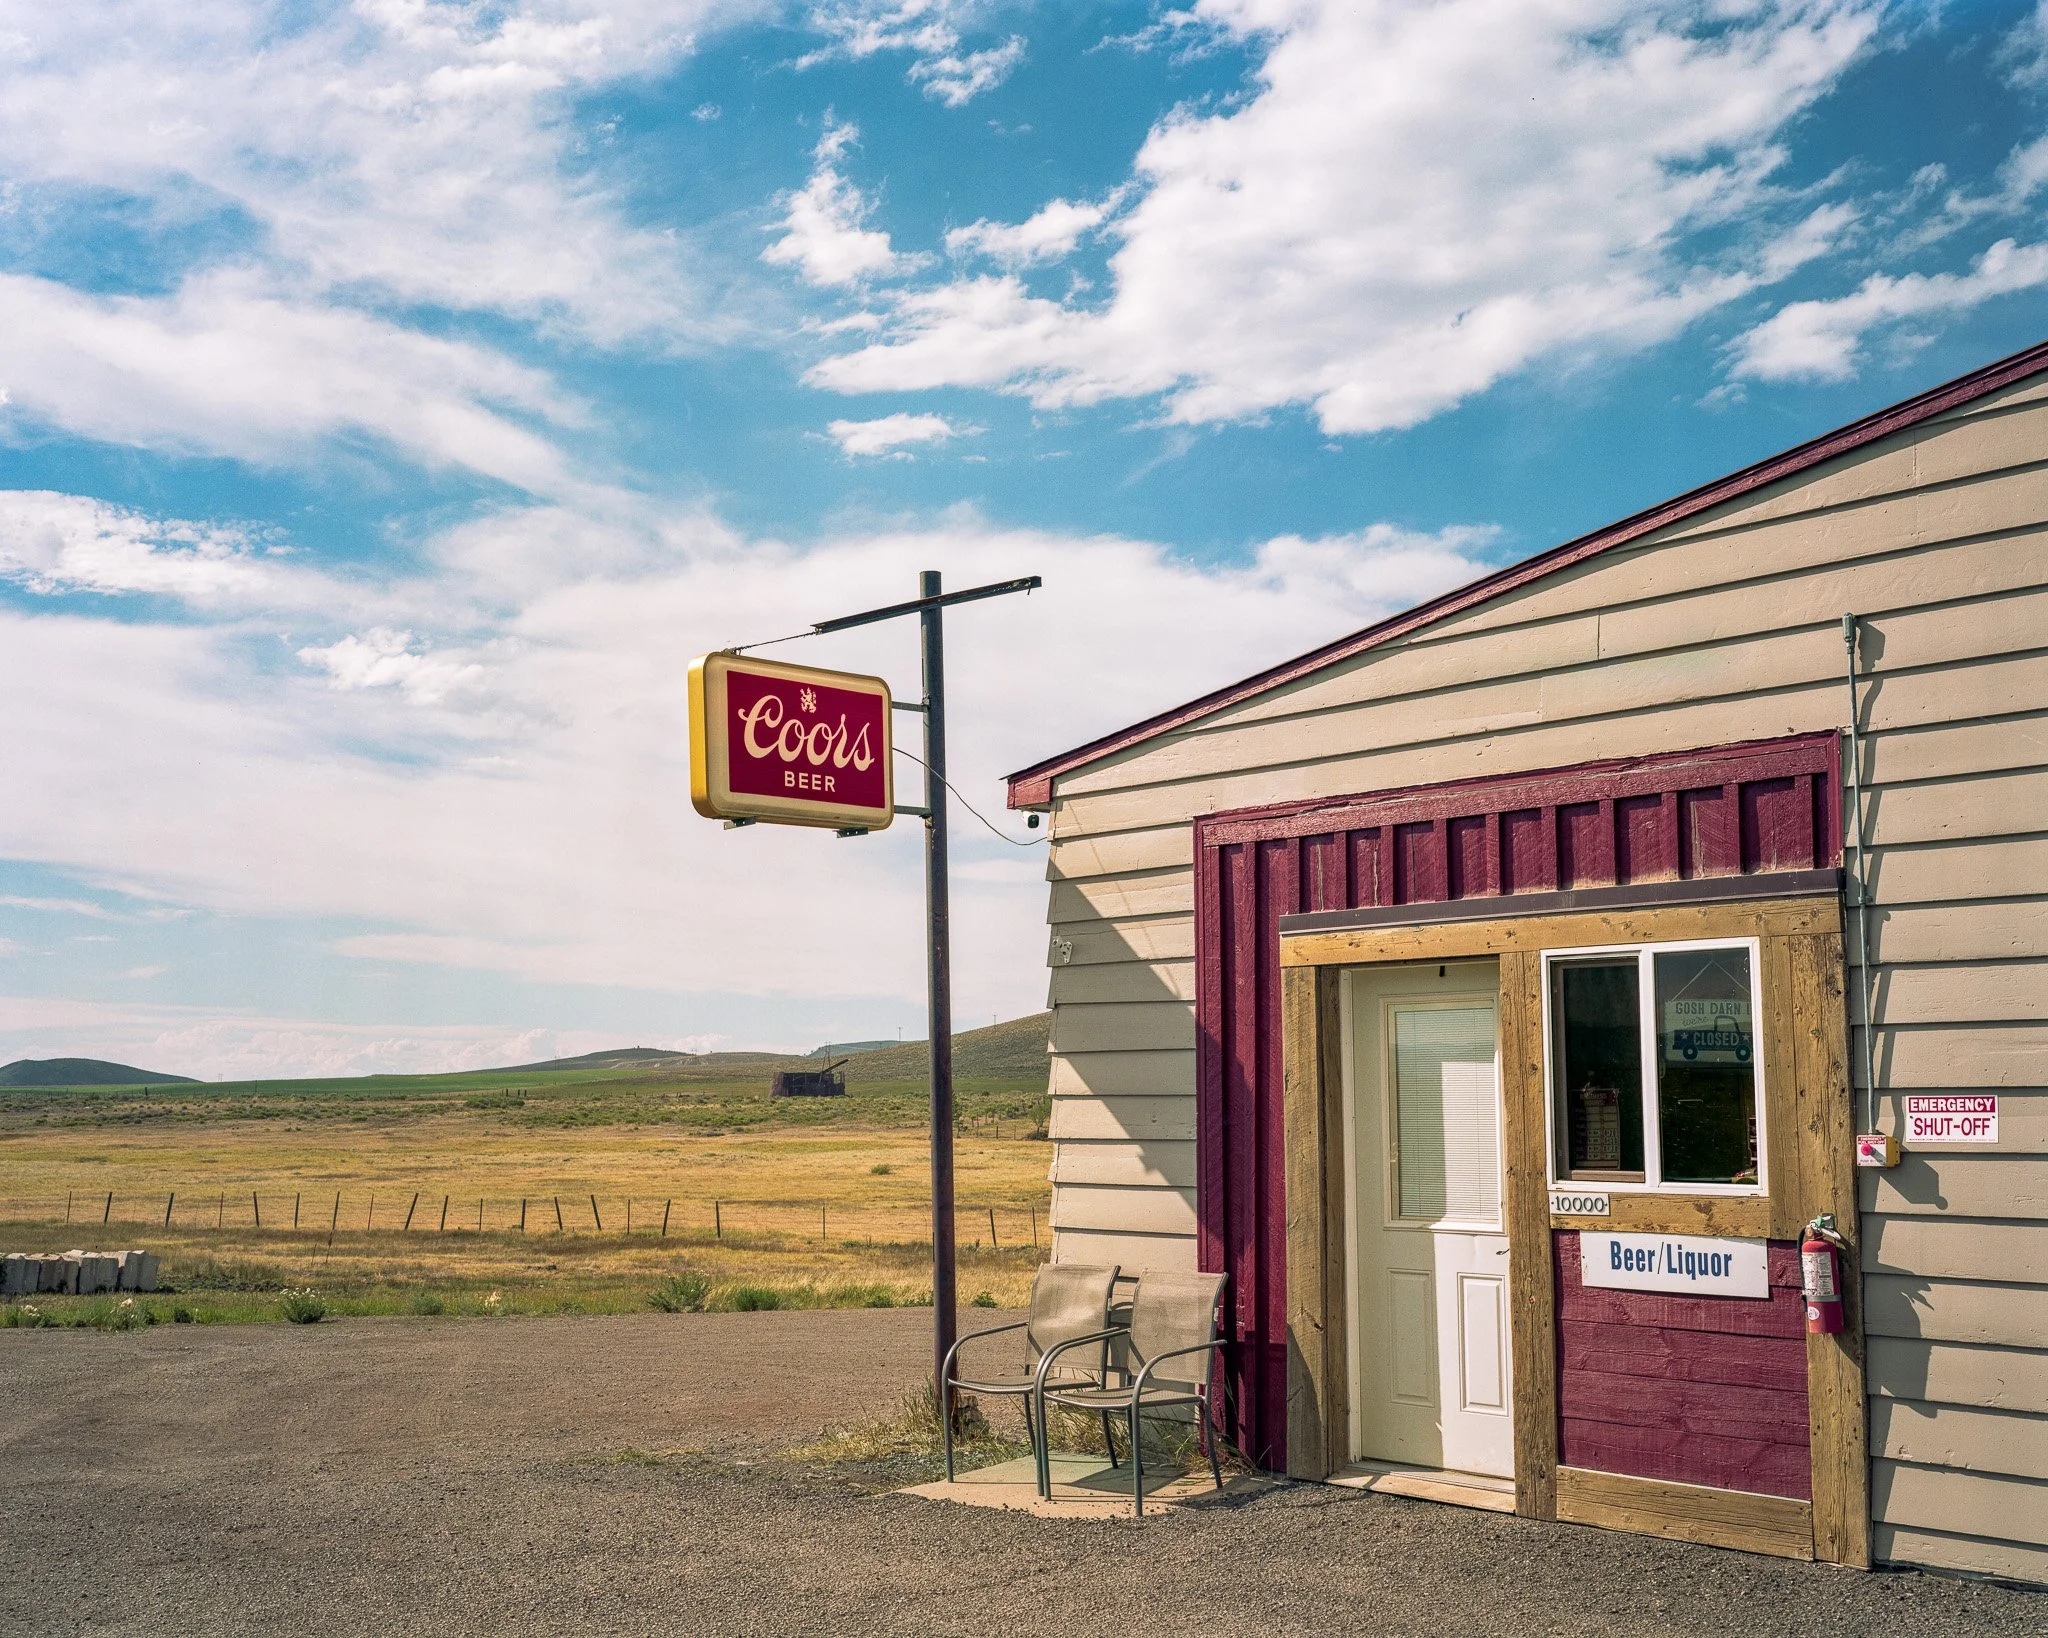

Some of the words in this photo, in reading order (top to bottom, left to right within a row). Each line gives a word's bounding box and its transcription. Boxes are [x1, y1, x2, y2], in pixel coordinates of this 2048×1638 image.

[737, 694, 875, 772] Coors
[784, 770, 836, 792] BEER
[1675, 1002, 1704, 1015] GOSH
[1710, 1002, 1741, 1015] DARN
[1693, 1032, 1740, 1046] CLOSED
[1909, 1098, 1994, 1111] EMERGENCY
[1913, 1117, 1991, 1136] SHUT-OFF
[1555, 1195, 1605, 1212] 10000
[1610, 1240, 1732, 1280] Beer/Liquor
